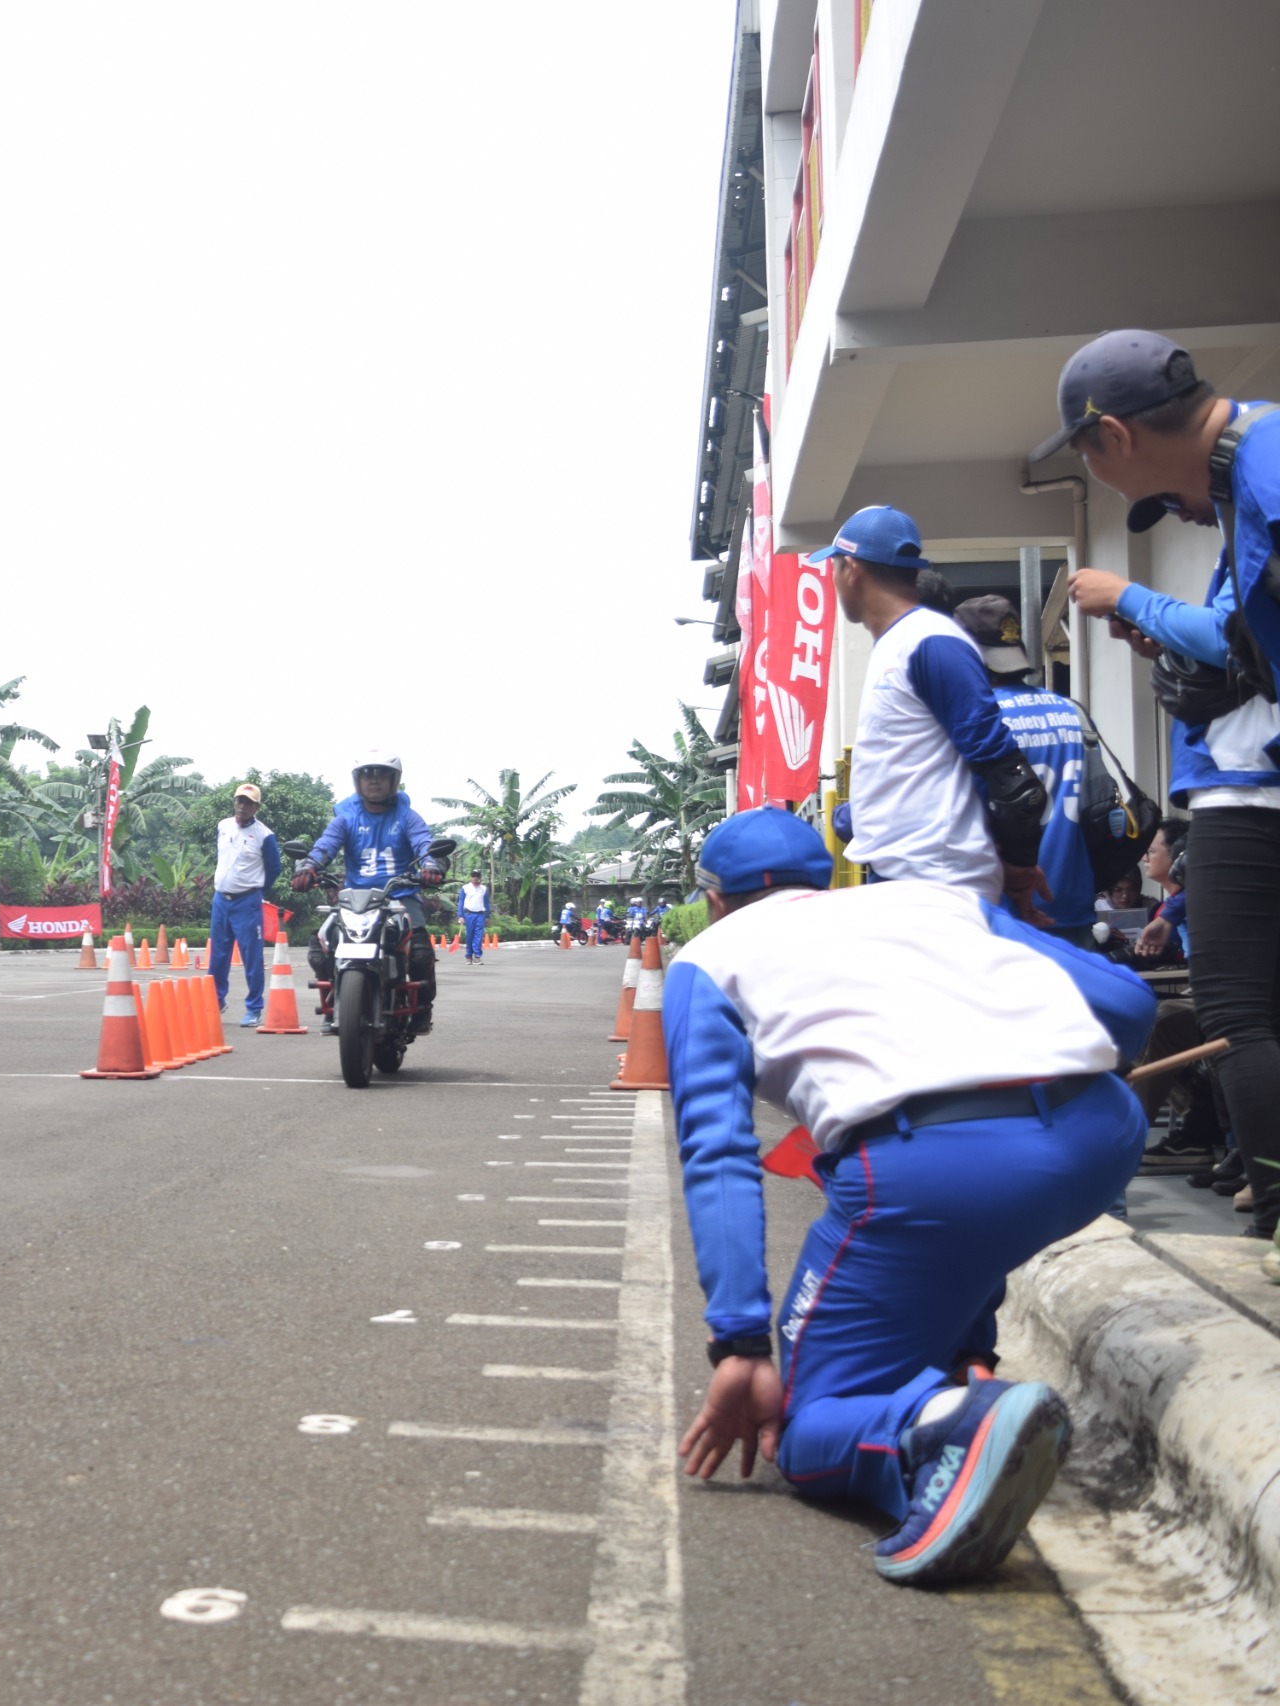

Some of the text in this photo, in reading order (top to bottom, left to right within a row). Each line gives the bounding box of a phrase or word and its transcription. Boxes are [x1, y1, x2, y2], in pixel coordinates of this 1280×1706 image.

[1001, 712, 1081, 731] Safety Ridin
[1012, 732, 1058, 749] ahana
[359, 846, 397, 877] 31
[297, 1413, 358, 1435] 8
[921, 1445, 966, 1513] HOKA
